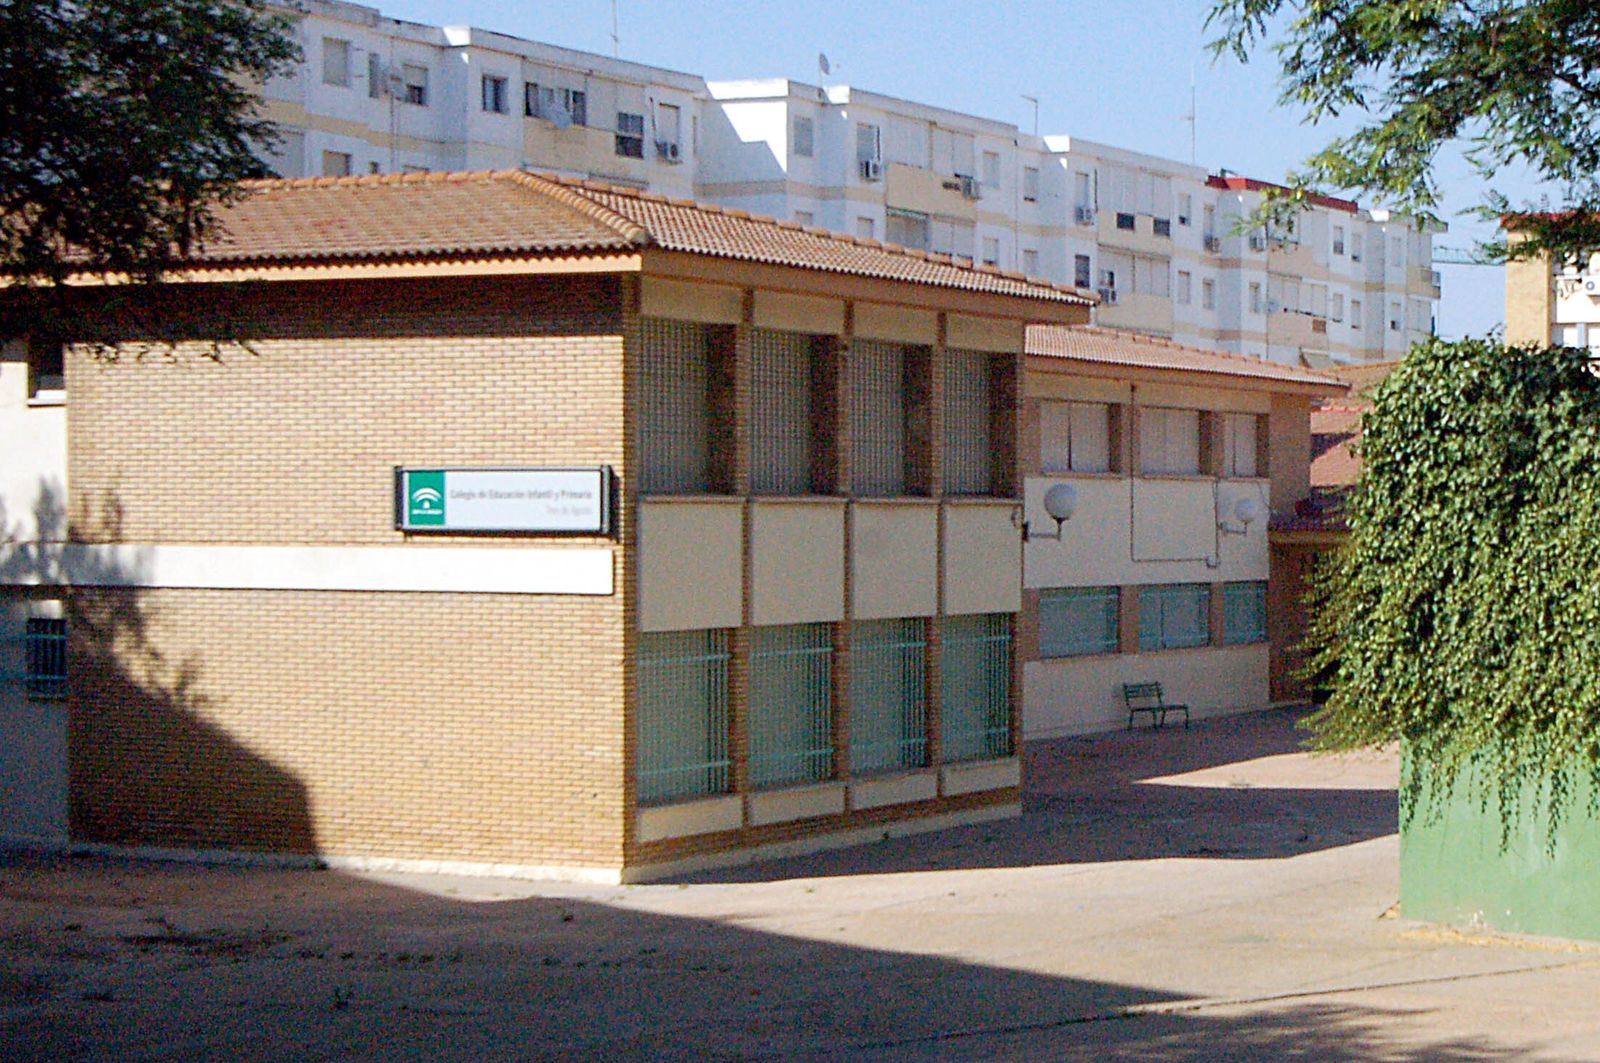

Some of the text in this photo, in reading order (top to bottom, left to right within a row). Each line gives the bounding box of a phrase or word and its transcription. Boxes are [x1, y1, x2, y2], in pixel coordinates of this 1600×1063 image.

[450, 489, 476, 501] Colegio
[530, 488, 553, 500] Infantil
[561, 489, 593, 500] Primaria
